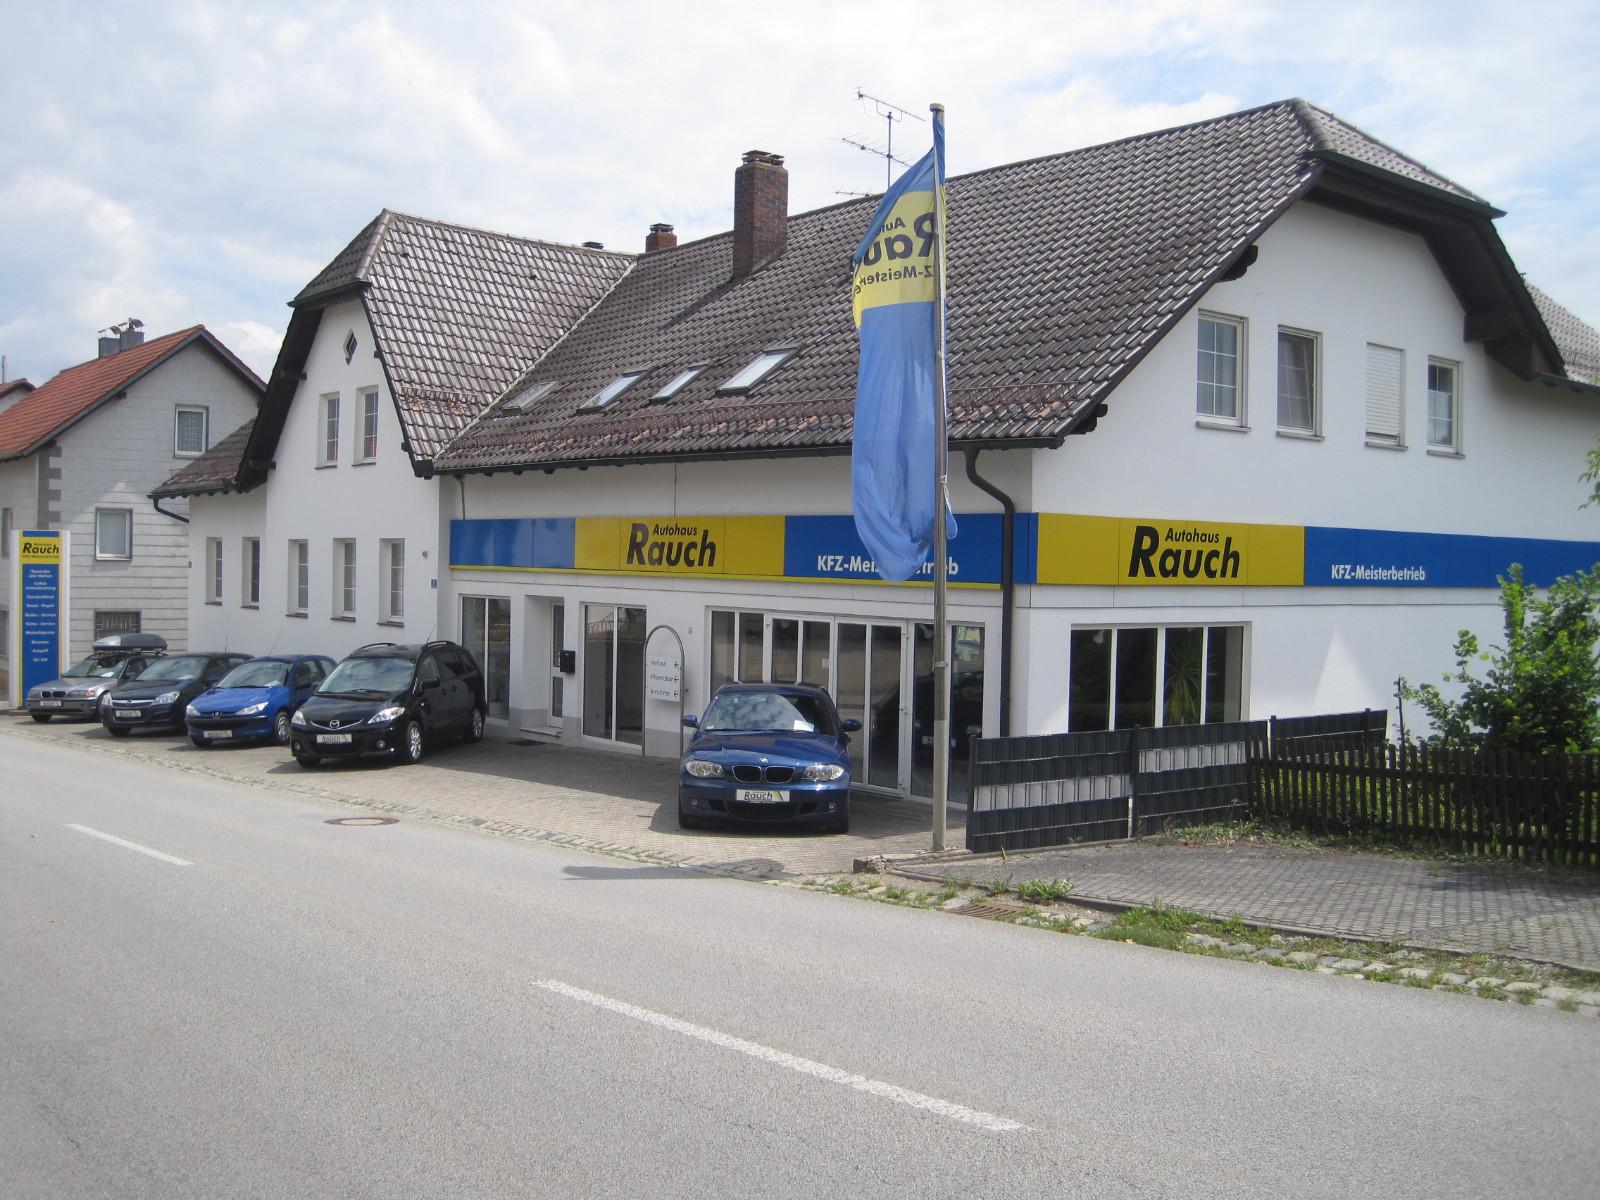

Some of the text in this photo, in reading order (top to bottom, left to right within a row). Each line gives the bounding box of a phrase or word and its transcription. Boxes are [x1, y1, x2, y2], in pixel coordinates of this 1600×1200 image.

[652, 523, 698, 537] Autohaus
[1164, 527, 1220, 544] Autohaus
[22, 542, 60, 554] Rauch
[627, 523, 717, 567] Rauch
[1127, 526, 1240, 579] Rauch
[1331, 564, 1426, 582] KFZ-Meisterbetrieb
[743, 791, 773, 801] Rauch
